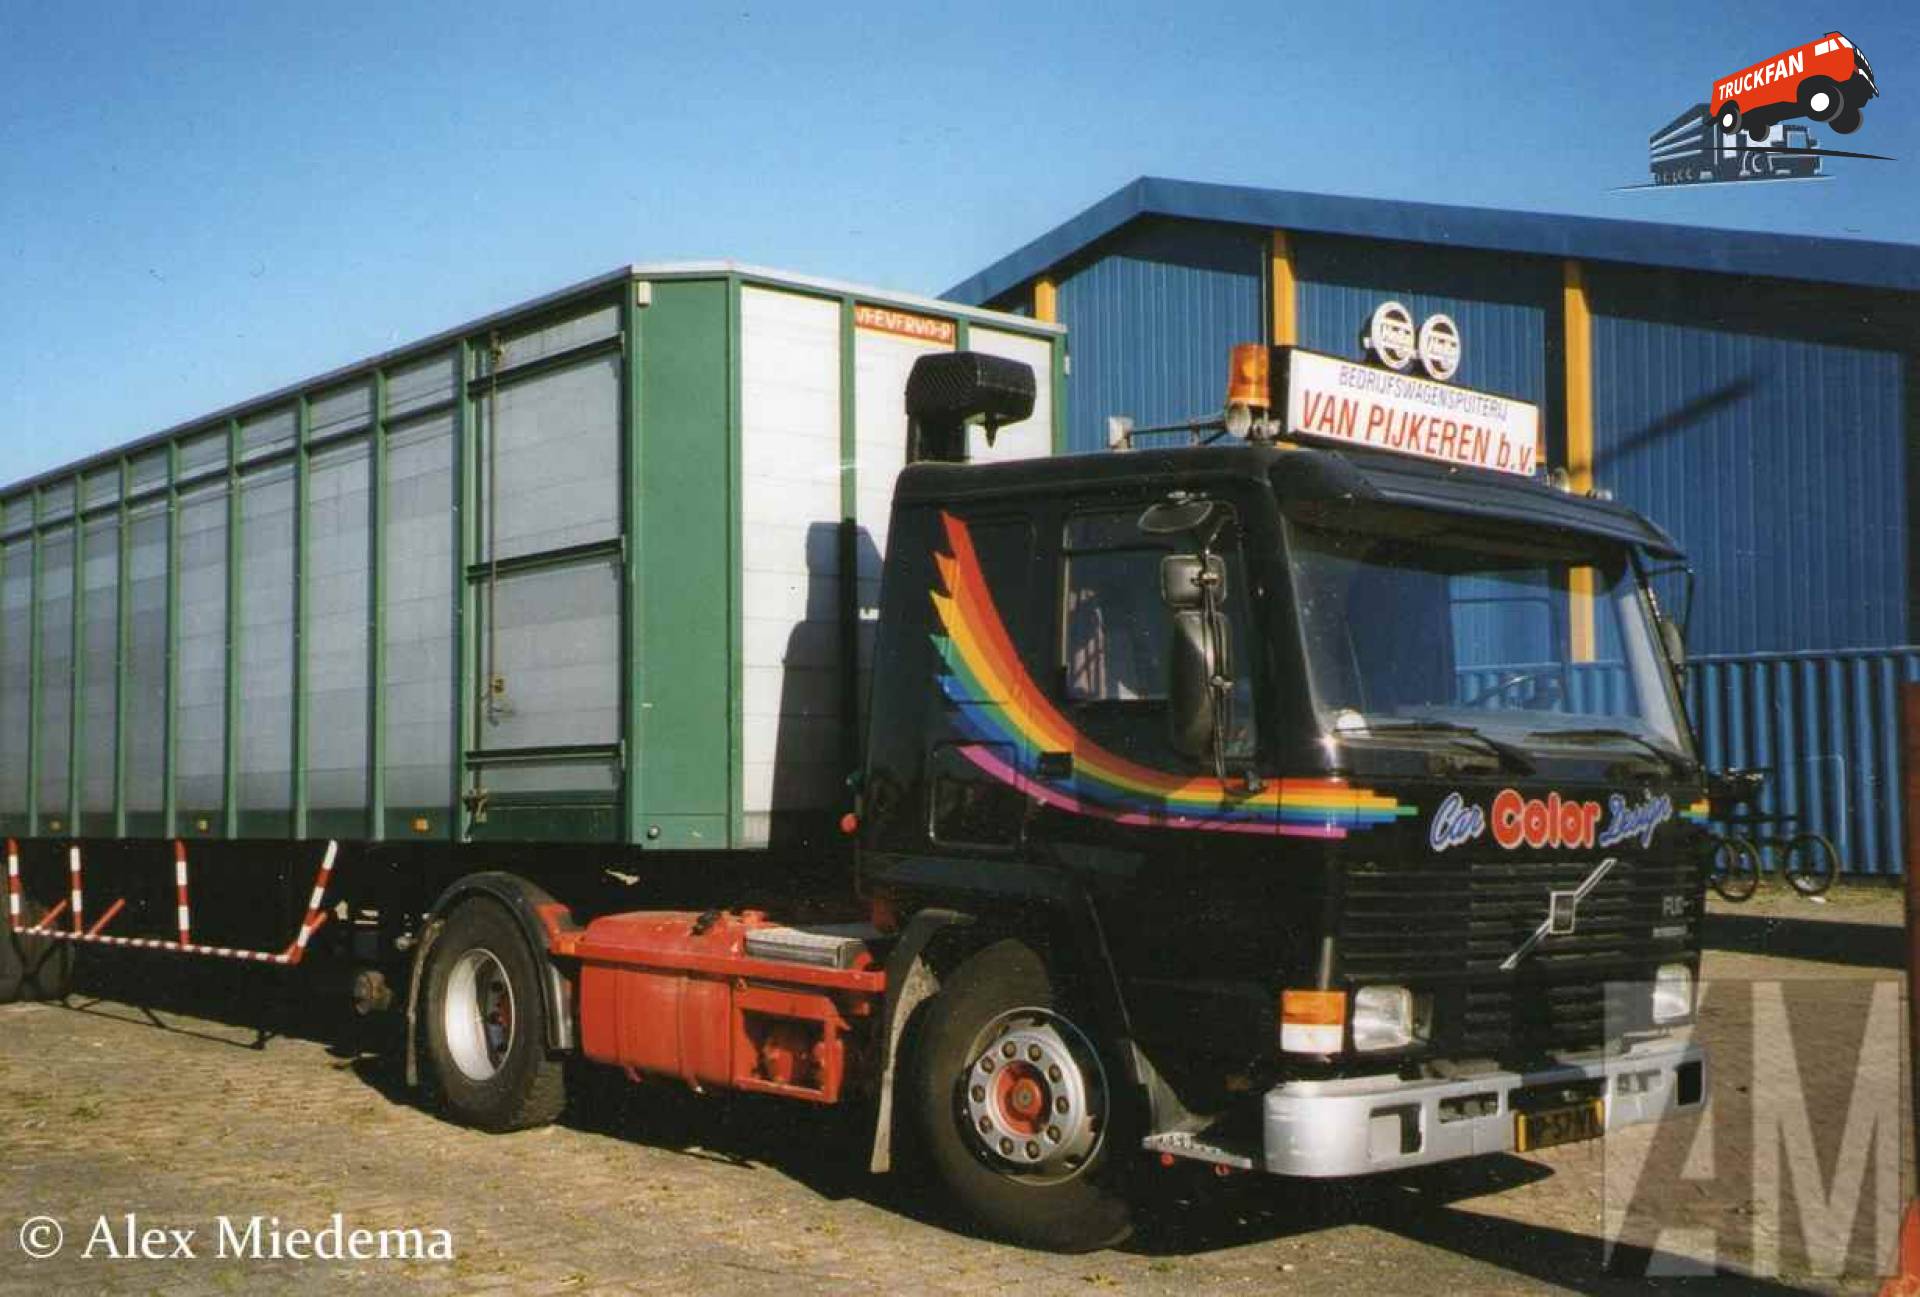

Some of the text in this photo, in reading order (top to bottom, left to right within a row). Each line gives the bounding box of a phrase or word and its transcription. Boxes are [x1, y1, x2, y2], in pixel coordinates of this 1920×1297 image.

[1338, 365, 1508, 421] BEDRIJFSWAGENSPUITERIJ
[1303, 389, 1359, 438] VAN
[1365, 404, 1492, 464] PIJKEREN
[1429, 792, 1486, 851] Car
[1491, 788, 1601, 849] Color
